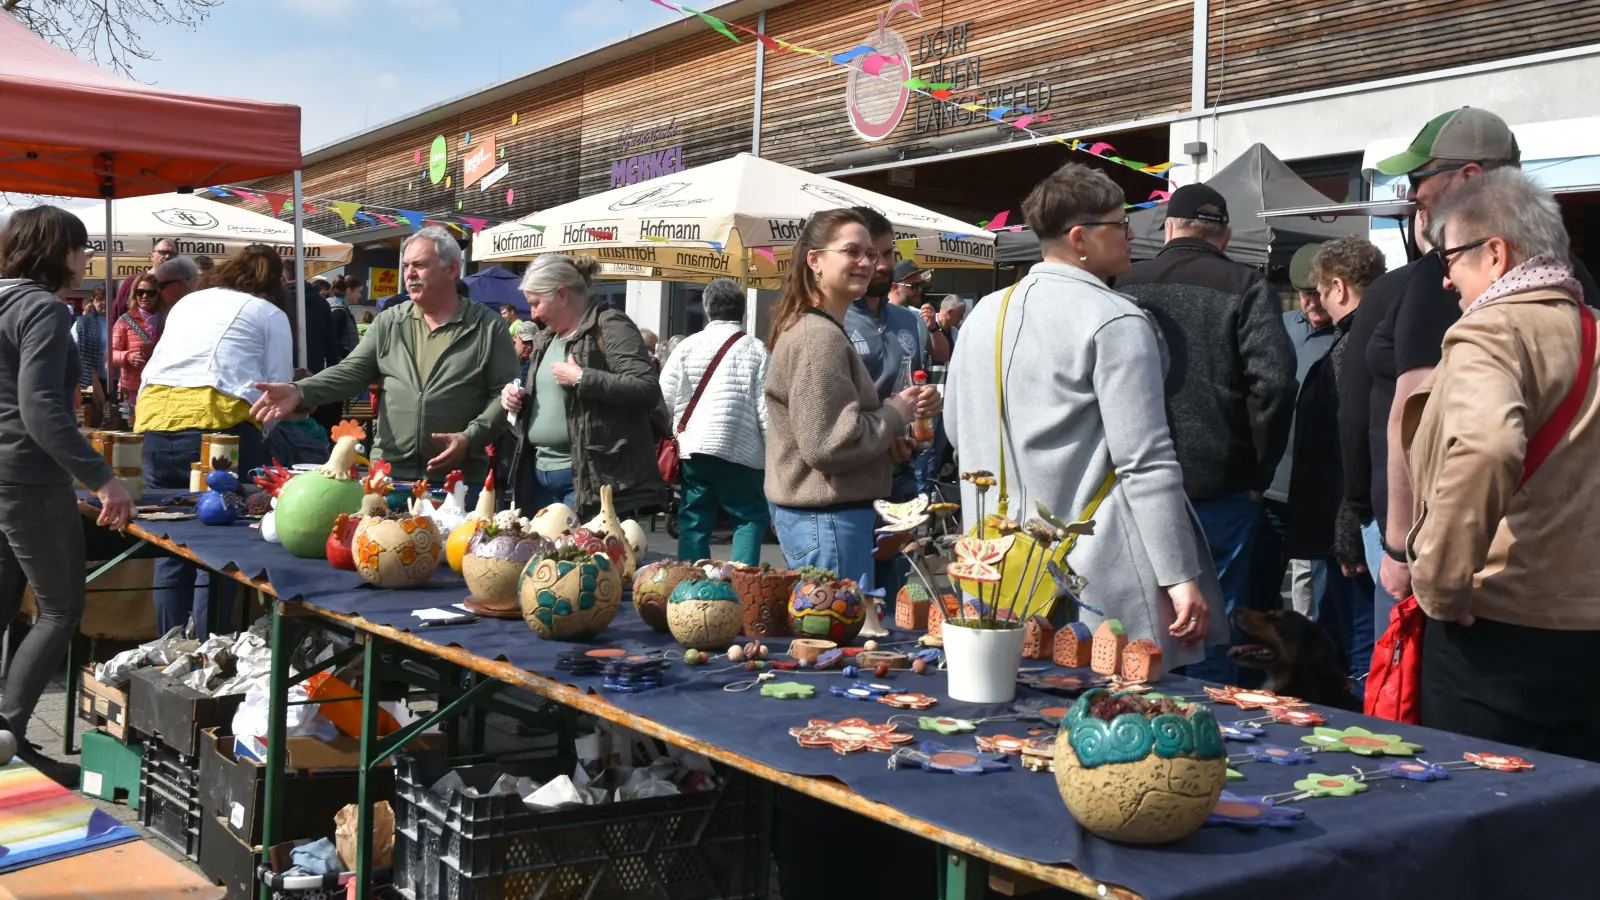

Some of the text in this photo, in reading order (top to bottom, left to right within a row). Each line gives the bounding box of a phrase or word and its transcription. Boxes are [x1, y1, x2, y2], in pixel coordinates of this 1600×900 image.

[918, 20, 974, 64] DORF
[917, 55, 981, 99] LADEN
[914, 79, 1052, 134] LANGENFELD
[611, 144, 686, 188] MERKEL
[492, 231, 544, 253] Hofmann
[639, 219, 701, 240] Hofmann
[152, 237, 225, 254] fmann
[938, 231, 994, 258] Hofmann
[374, 284, 398, 293] LOTTO
